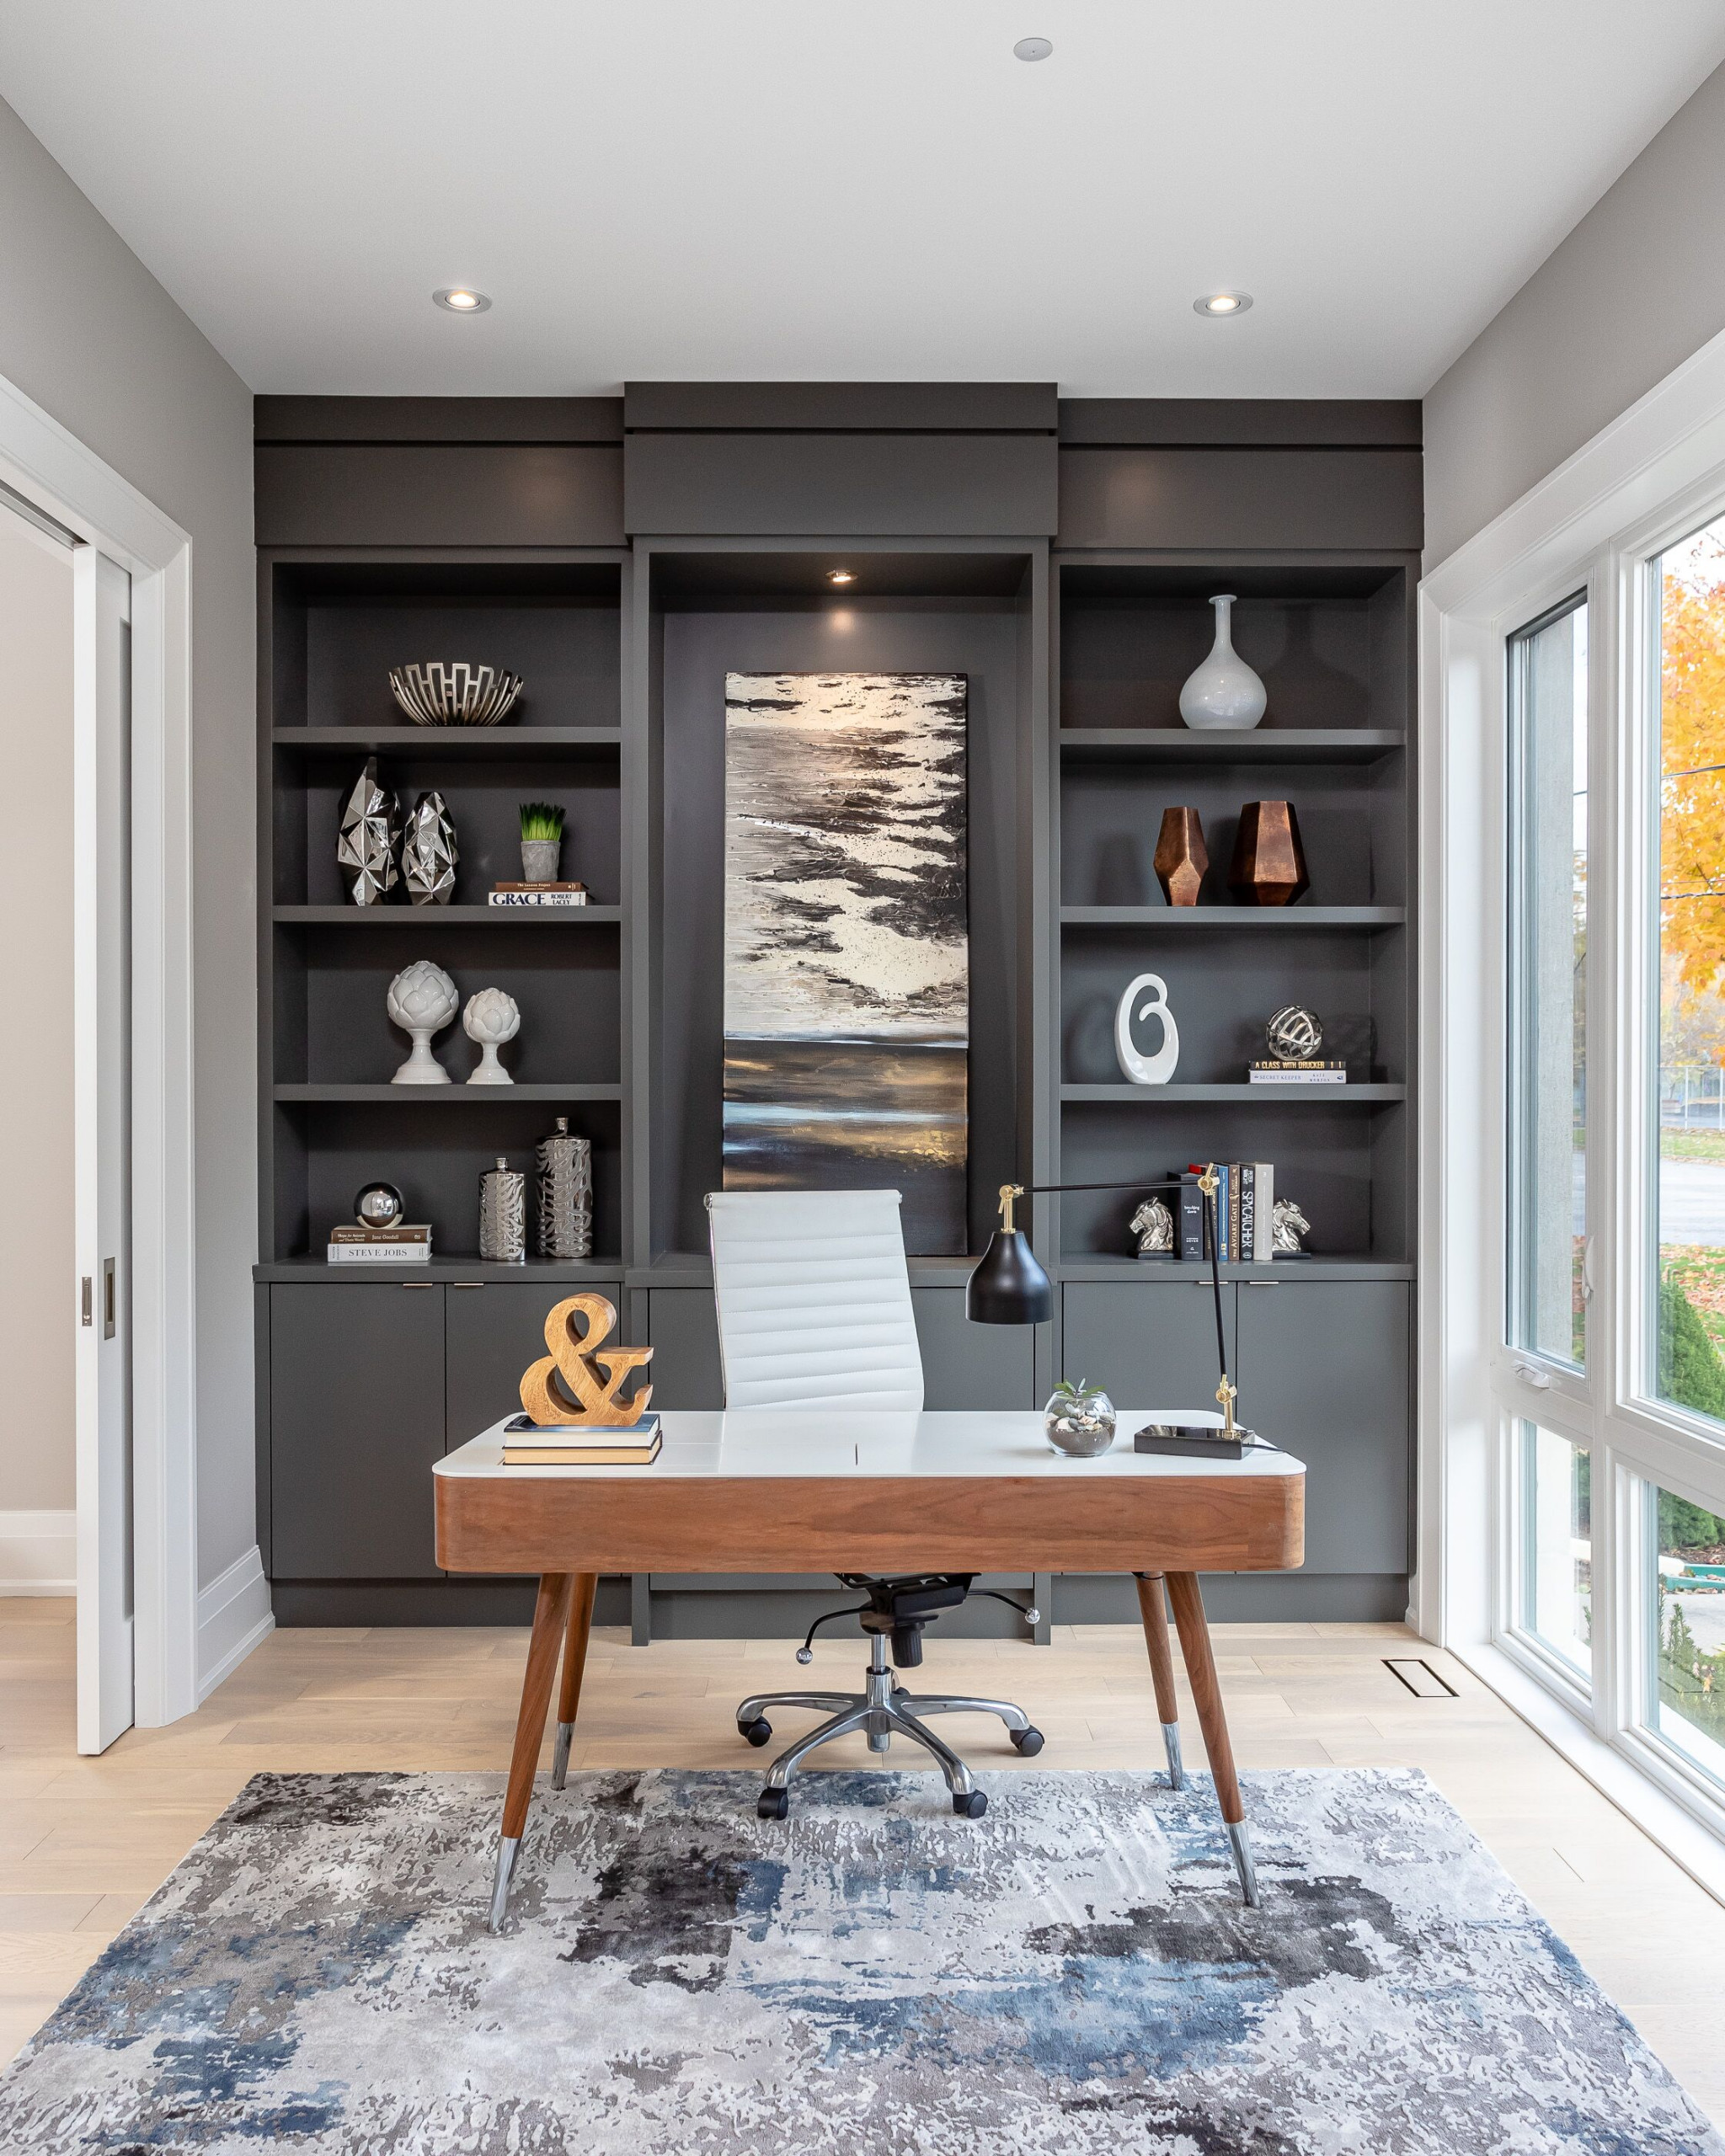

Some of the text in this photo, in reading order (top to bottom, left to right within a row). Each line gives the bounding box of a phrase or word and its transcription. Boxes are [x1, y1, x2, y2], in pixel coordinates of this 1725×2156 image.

[492, 894, 547, 905] GRACE
[1298, 1061, 1325, 1070] DRUCKER
[1242, 1191, 1253, 1248] SPYCATCHER
